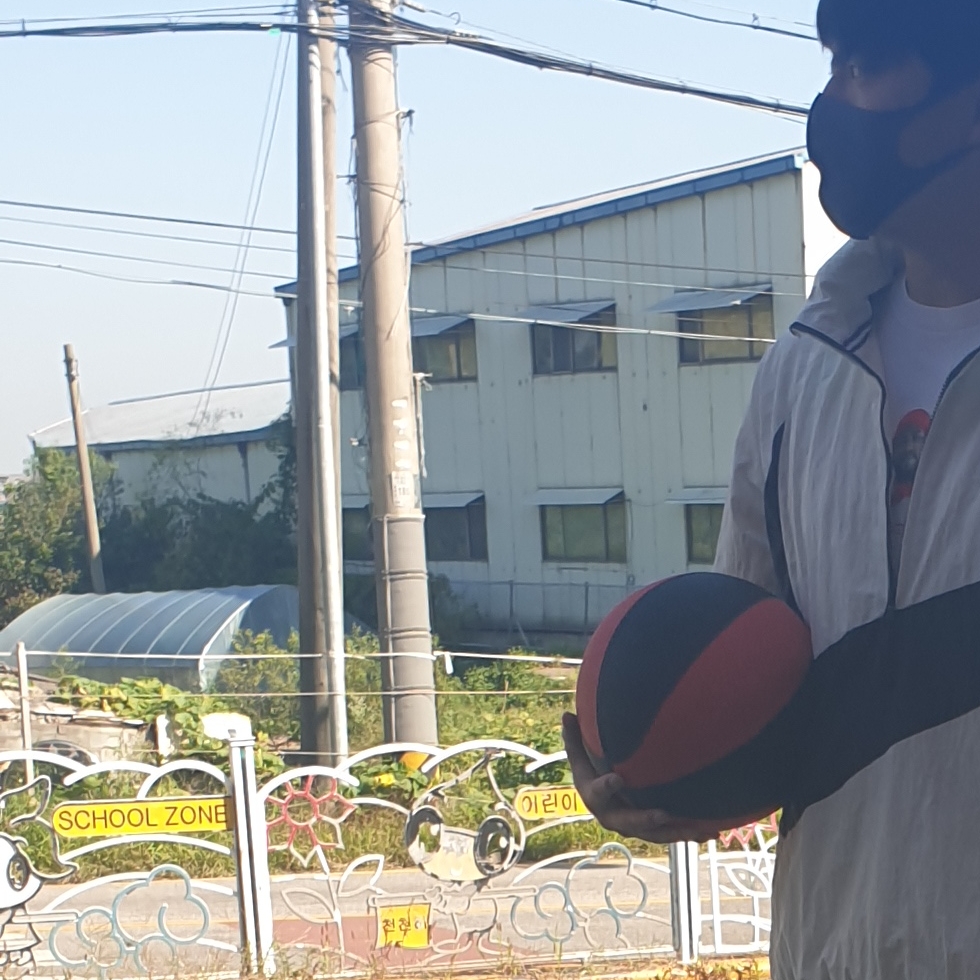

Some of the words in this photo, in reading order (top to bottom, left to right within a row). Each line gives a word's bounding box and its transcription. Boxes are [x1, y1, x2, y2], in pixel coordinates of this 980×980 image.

[521, 792, 577, 814] 어린이
[58, 807, 158, 831] SCHOOL
[164, 804, 227, 826] ZONE
